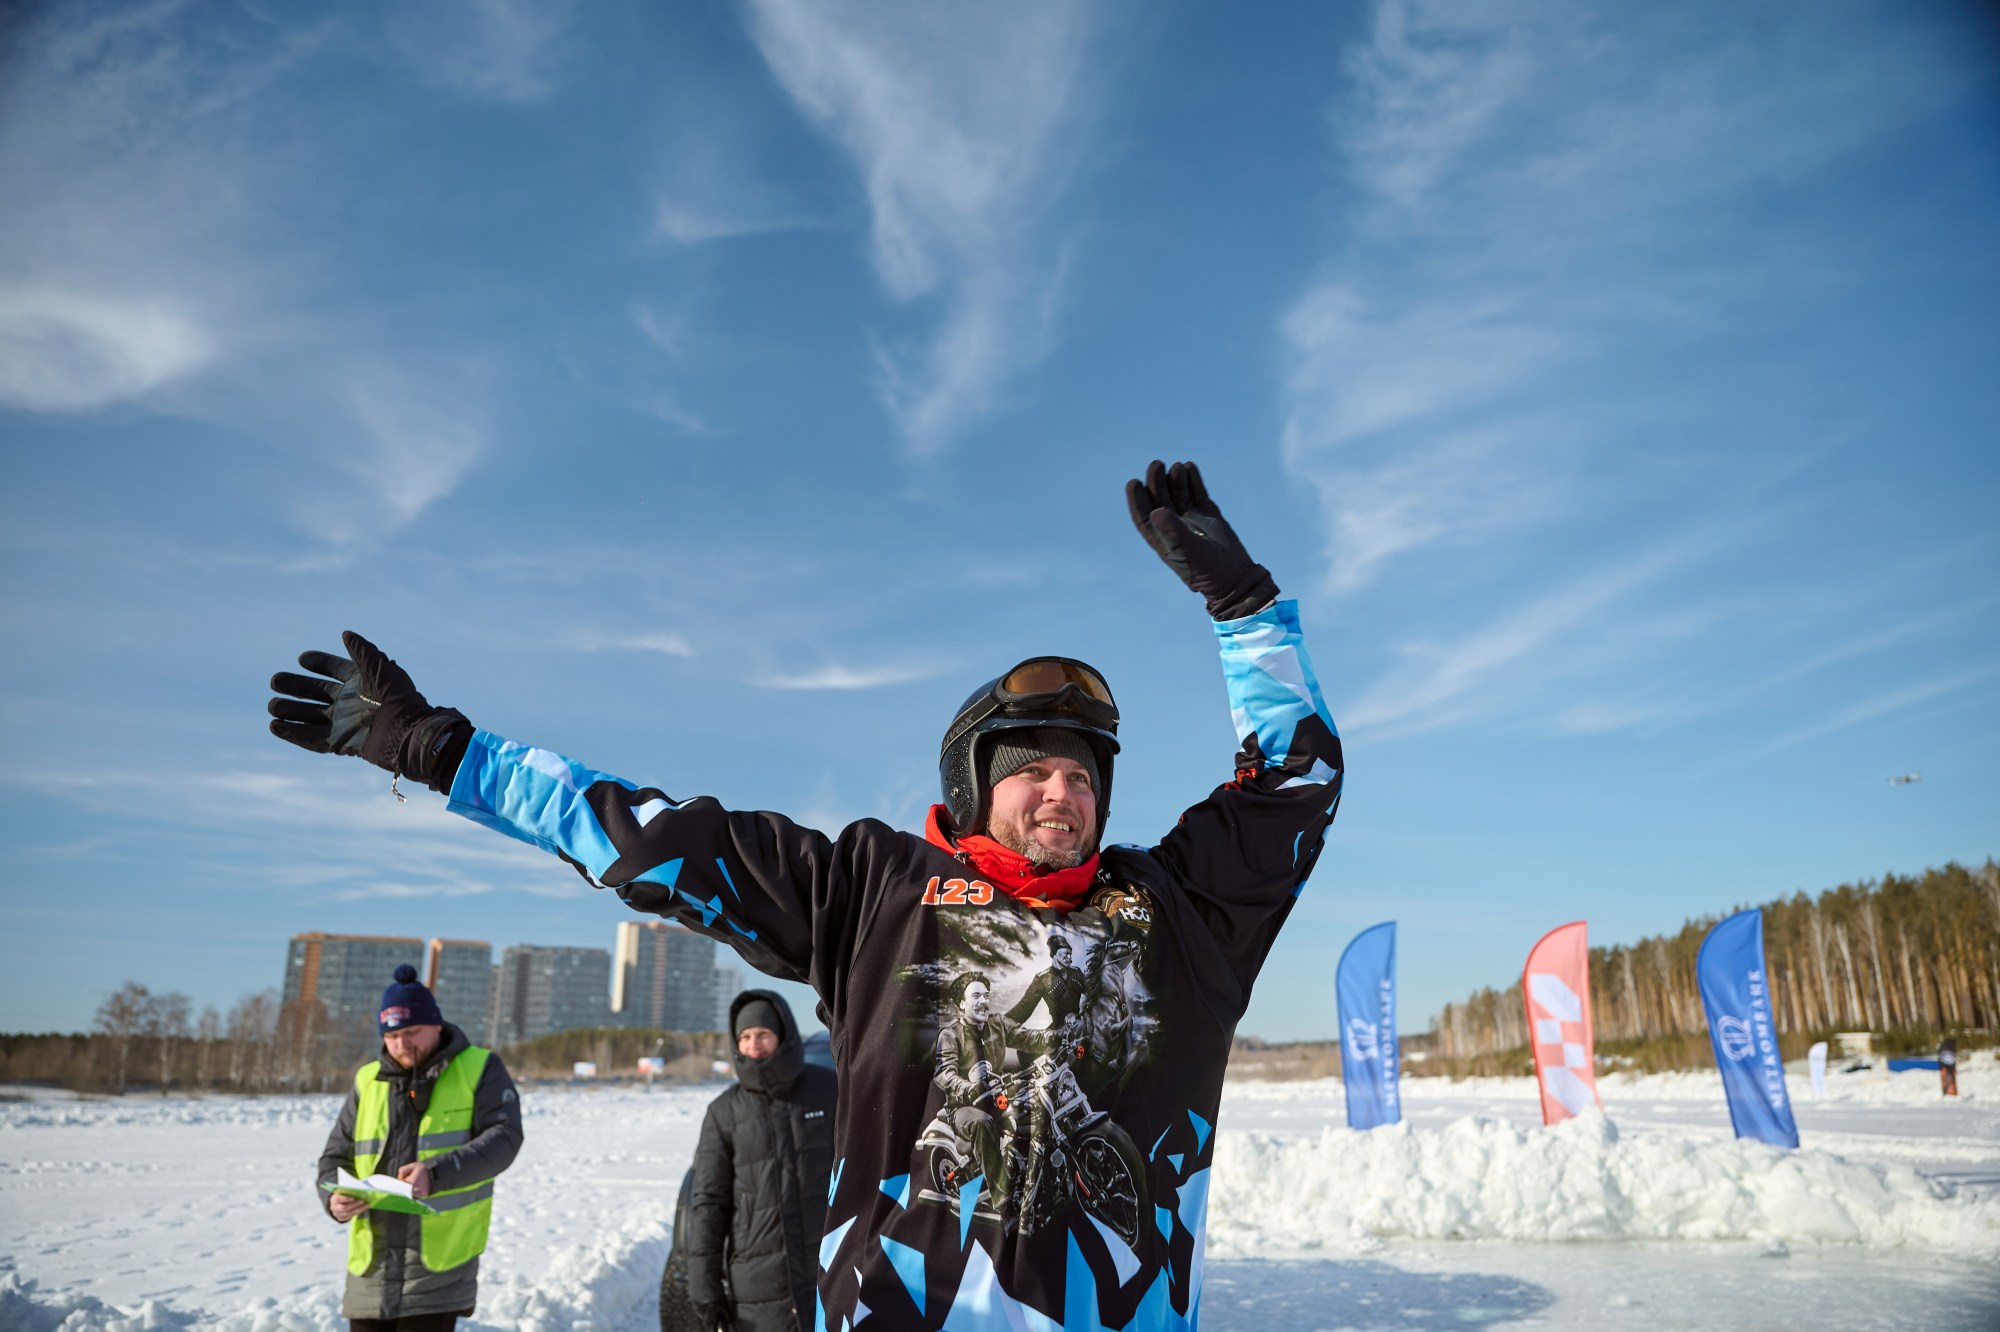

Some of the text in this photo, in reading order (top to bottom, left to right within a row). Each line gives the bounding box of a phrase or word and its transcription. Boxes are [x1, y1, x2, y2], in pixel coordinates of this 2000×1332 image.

[943, 713, 974, 748] uvex
[921, 876, 994, 905] 123
[1119, 906, 1151, 923] HOG
